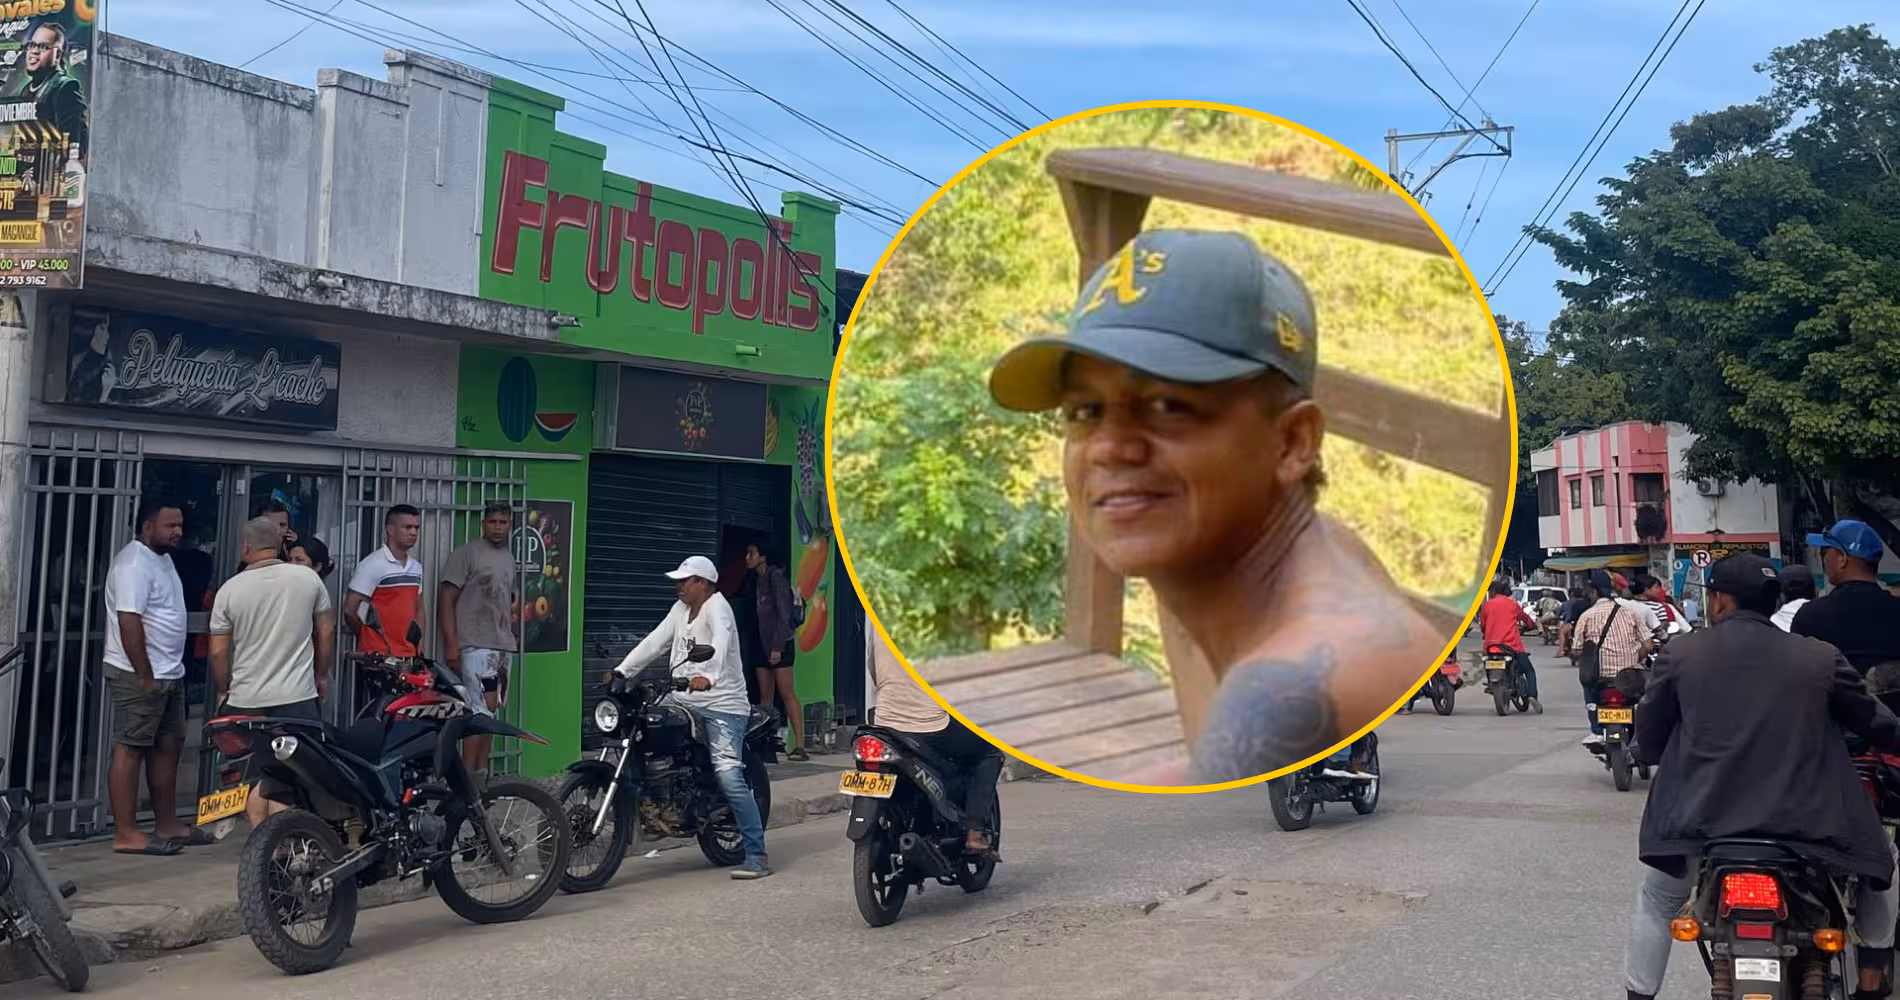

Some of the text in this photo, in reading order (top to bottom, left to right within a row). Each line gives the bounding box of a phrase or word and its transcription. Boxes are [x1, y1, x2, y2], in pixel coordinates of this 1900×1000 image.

[491, 150, 822, 335] Frutopolis
[7, 275, 25, 285] 793
[25, 275, 47, 286] 9162
[20, 259, 37, 270] VIP
[38, 259, 69, 271] 45.000
[120, 328, 241, 398] Peluquería
